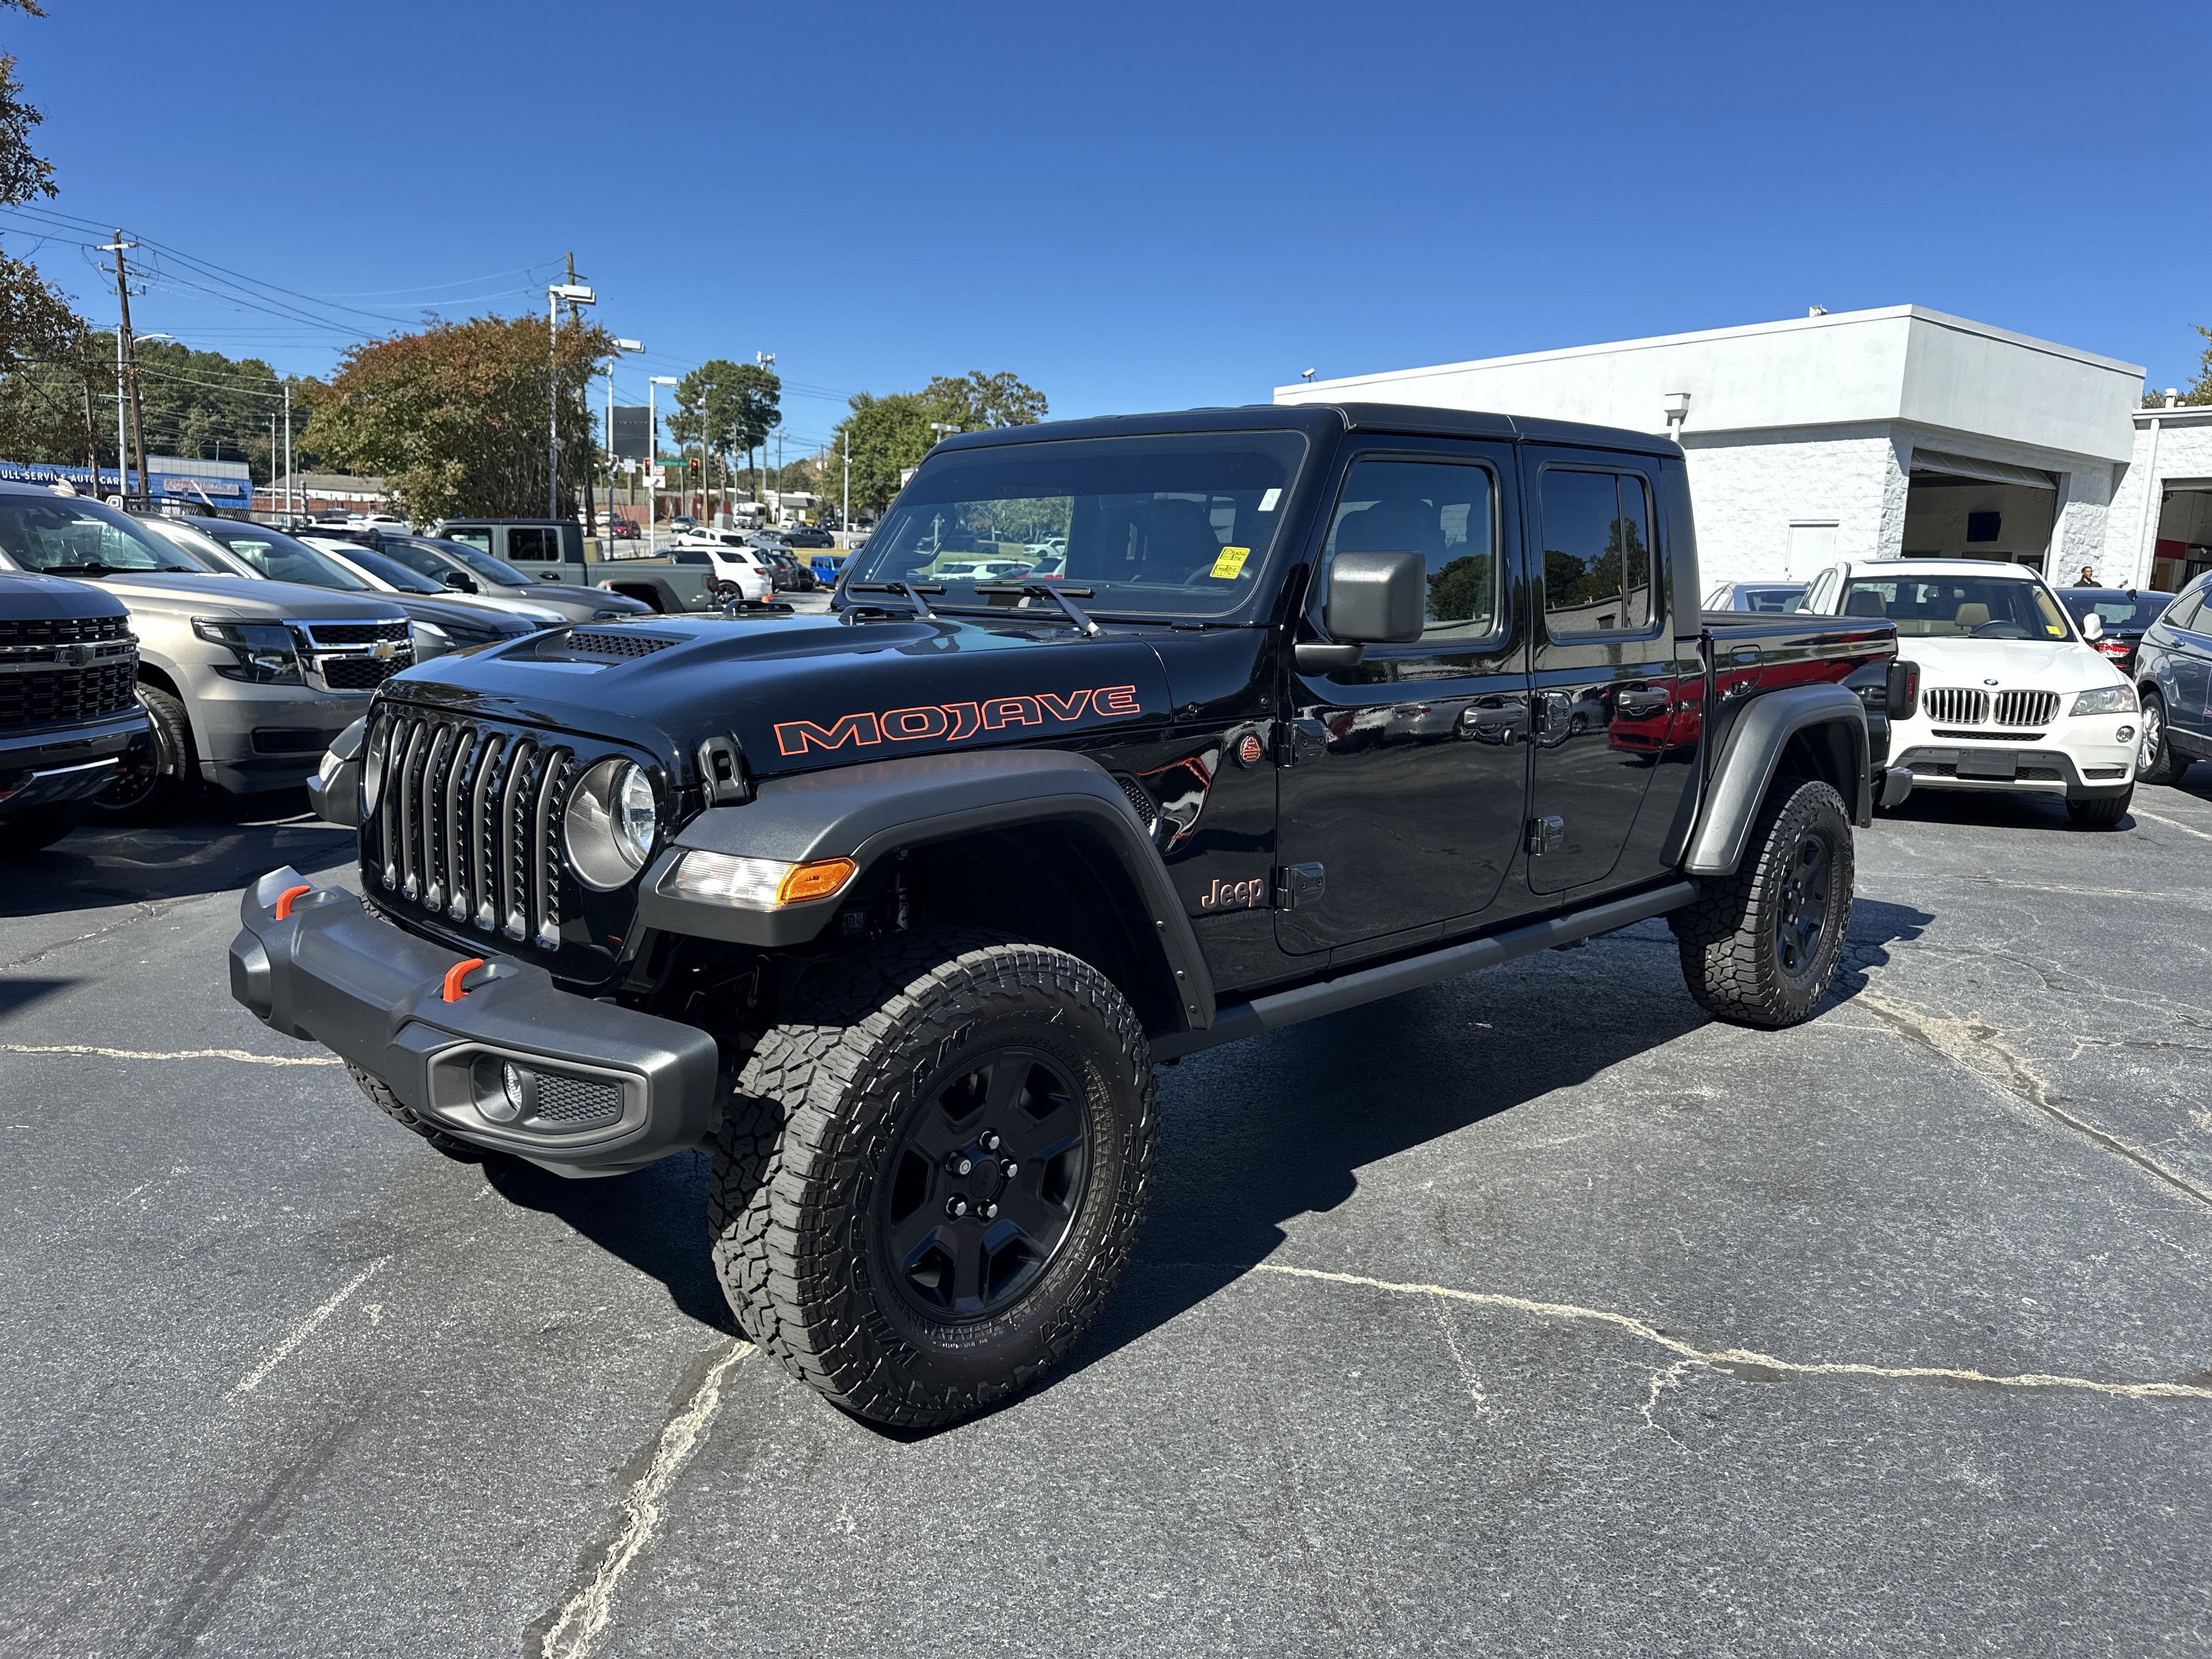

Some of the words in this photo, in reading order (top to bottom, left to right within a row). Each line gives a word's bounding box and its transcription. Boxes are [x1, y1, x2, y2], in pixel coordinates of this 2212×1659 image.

[0, 470, 20, 479] ULL
[99, 476, 123, 485] CAR
[774, 685, 1140, 755] MOJAVE
[1202, 879, 1263, 910] Jeep
